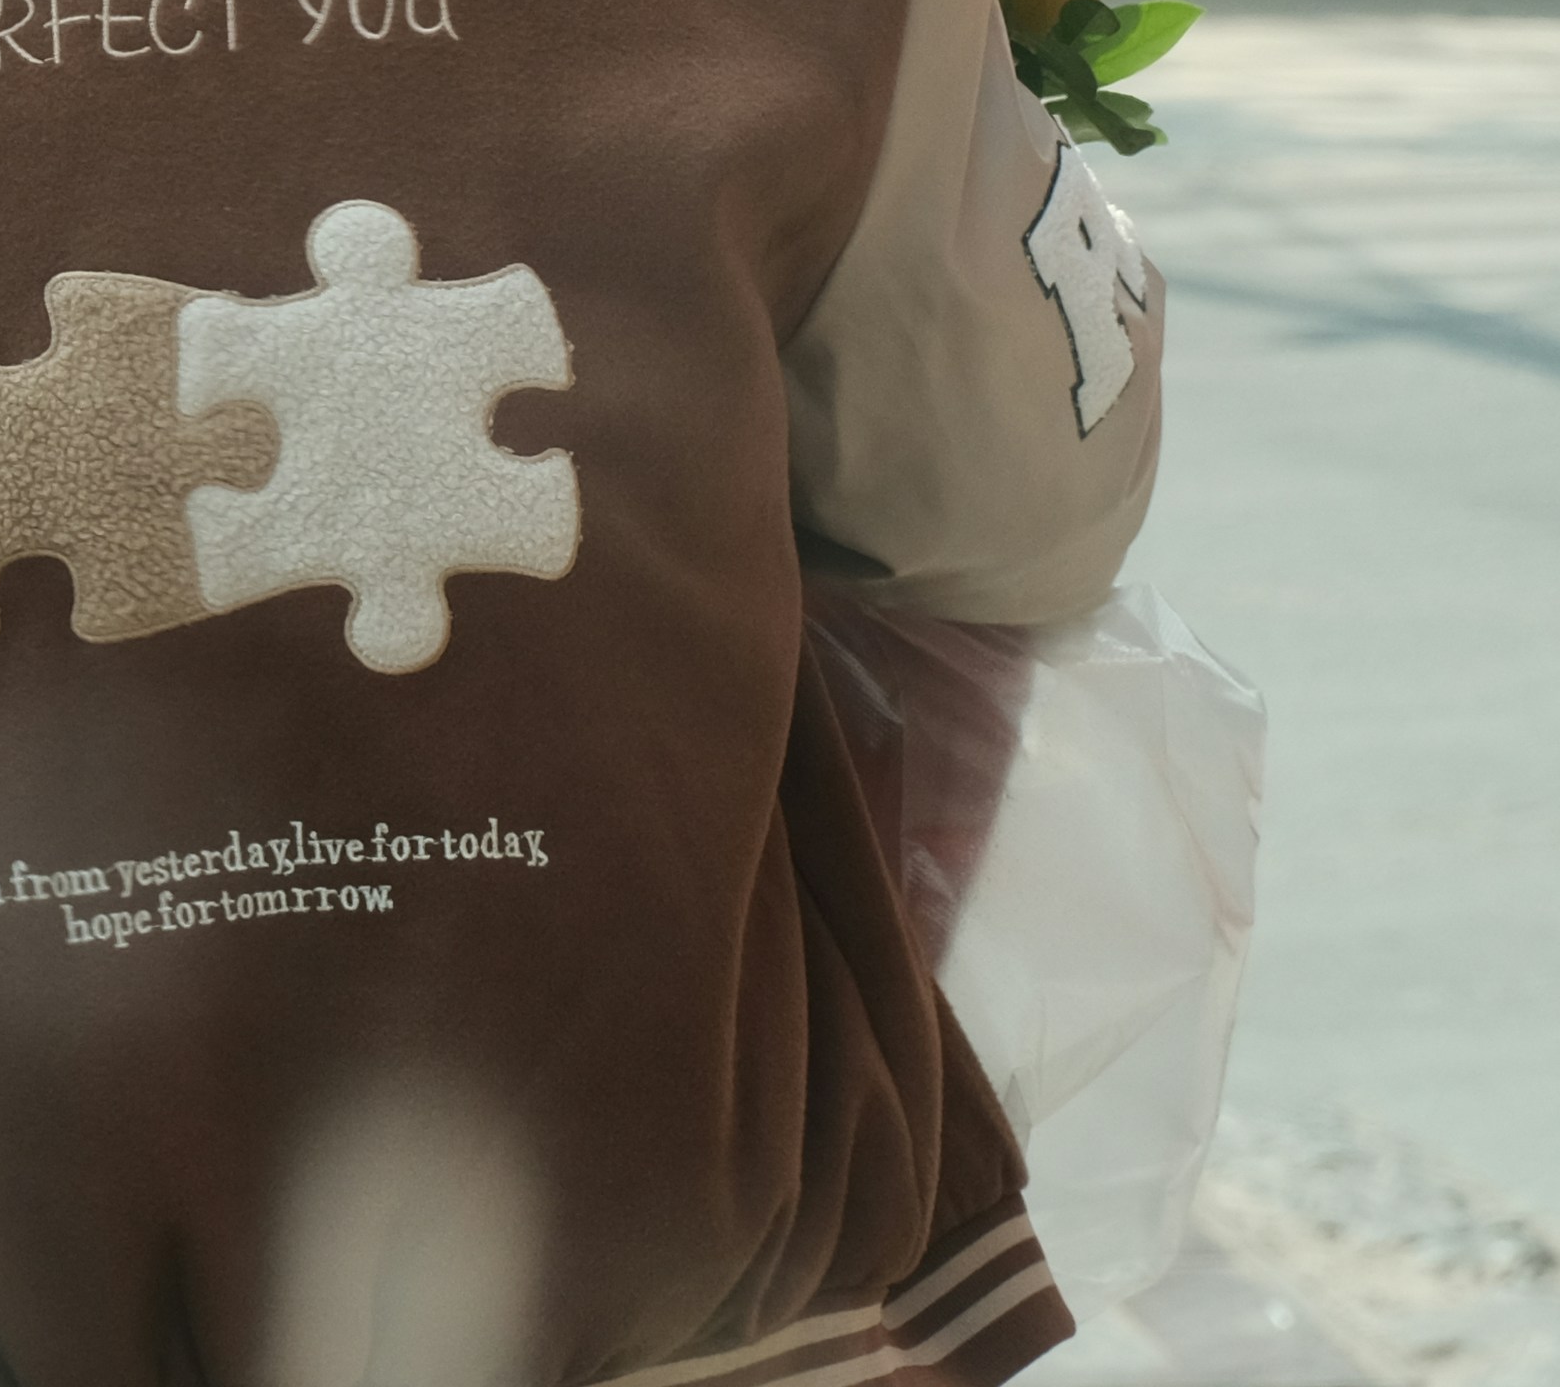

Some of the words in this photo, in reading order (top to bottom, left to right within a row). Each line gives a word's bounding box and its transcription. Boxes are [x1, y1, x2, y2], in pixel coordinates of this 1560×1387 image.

[10, 860, 110, 901] from
[371, 822, 435, 863] for
[440, 818, 549, 867] today,
[60, 904, 153, 948] hope
[156, 890, 219, 930] for
